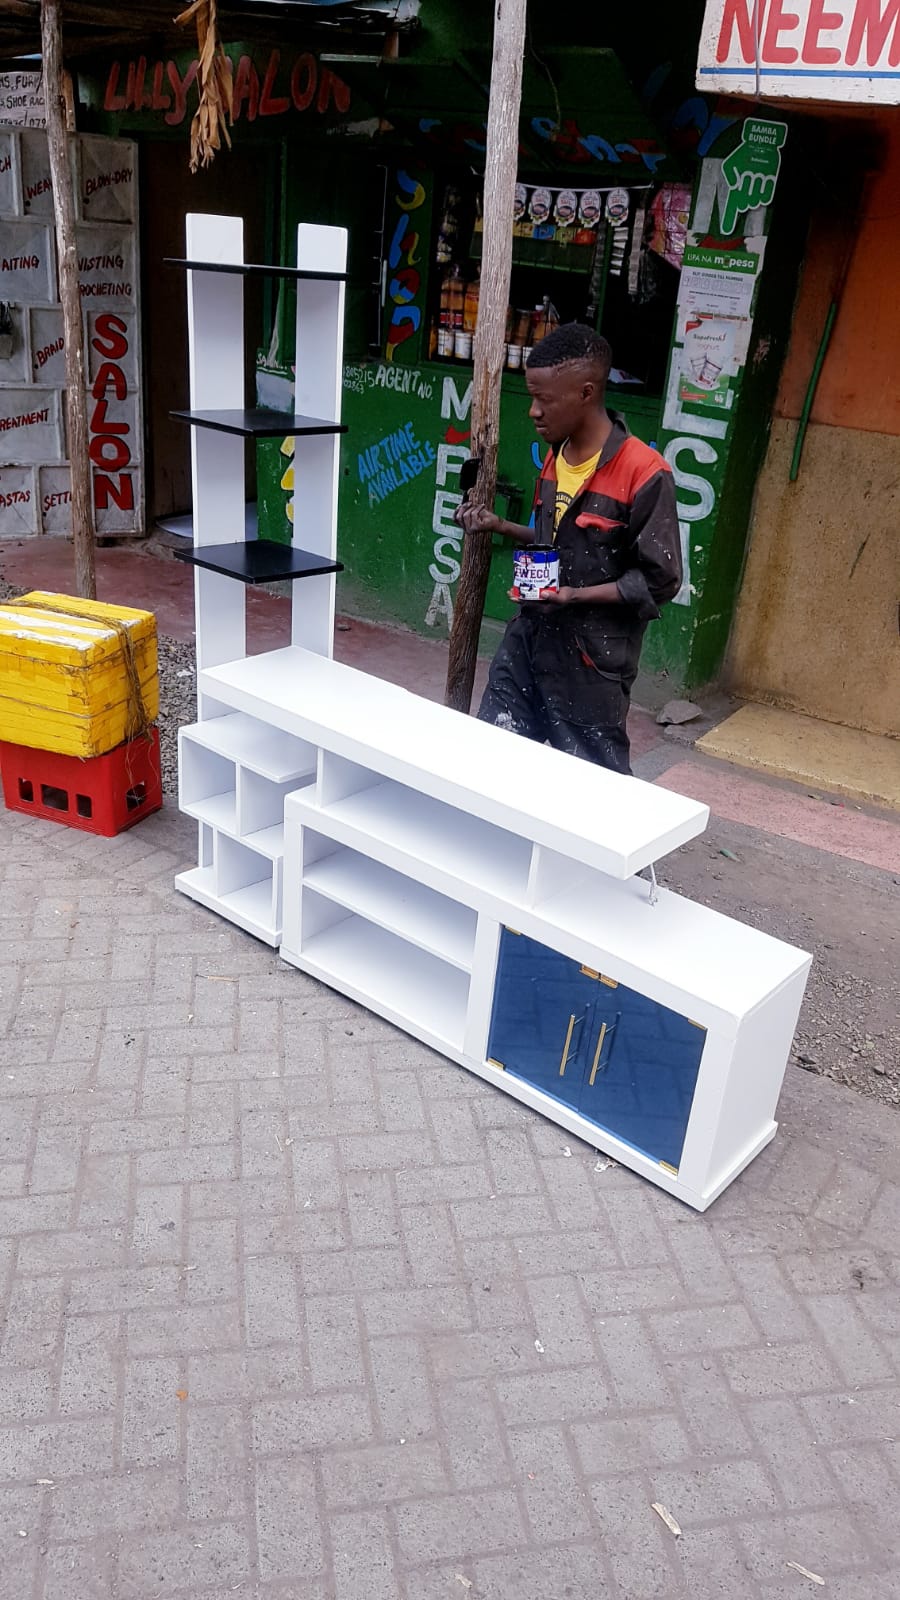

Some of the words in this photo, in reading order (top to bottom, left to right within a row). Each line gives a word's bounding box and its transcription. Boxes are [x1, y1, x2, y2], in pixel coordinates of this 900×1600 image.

[103, 55, 200, 126] LILLY
[217, 49, 350, 122] ALON
[7, 95, 28, 109] SHOE
[749, 133, 777, 145] BUNDLE
[752, 124, 777, 136] BAMBA
[86, 168, 133, 196] BLOW-DRY
[1, 256, 40, 271] AITING
[702, 254, 712, 264] NA
[375, 365, 421, 394] AGENT
[89, 314, 135, 510] SALON
[367, 440, 437, 508] AVAILABLE
